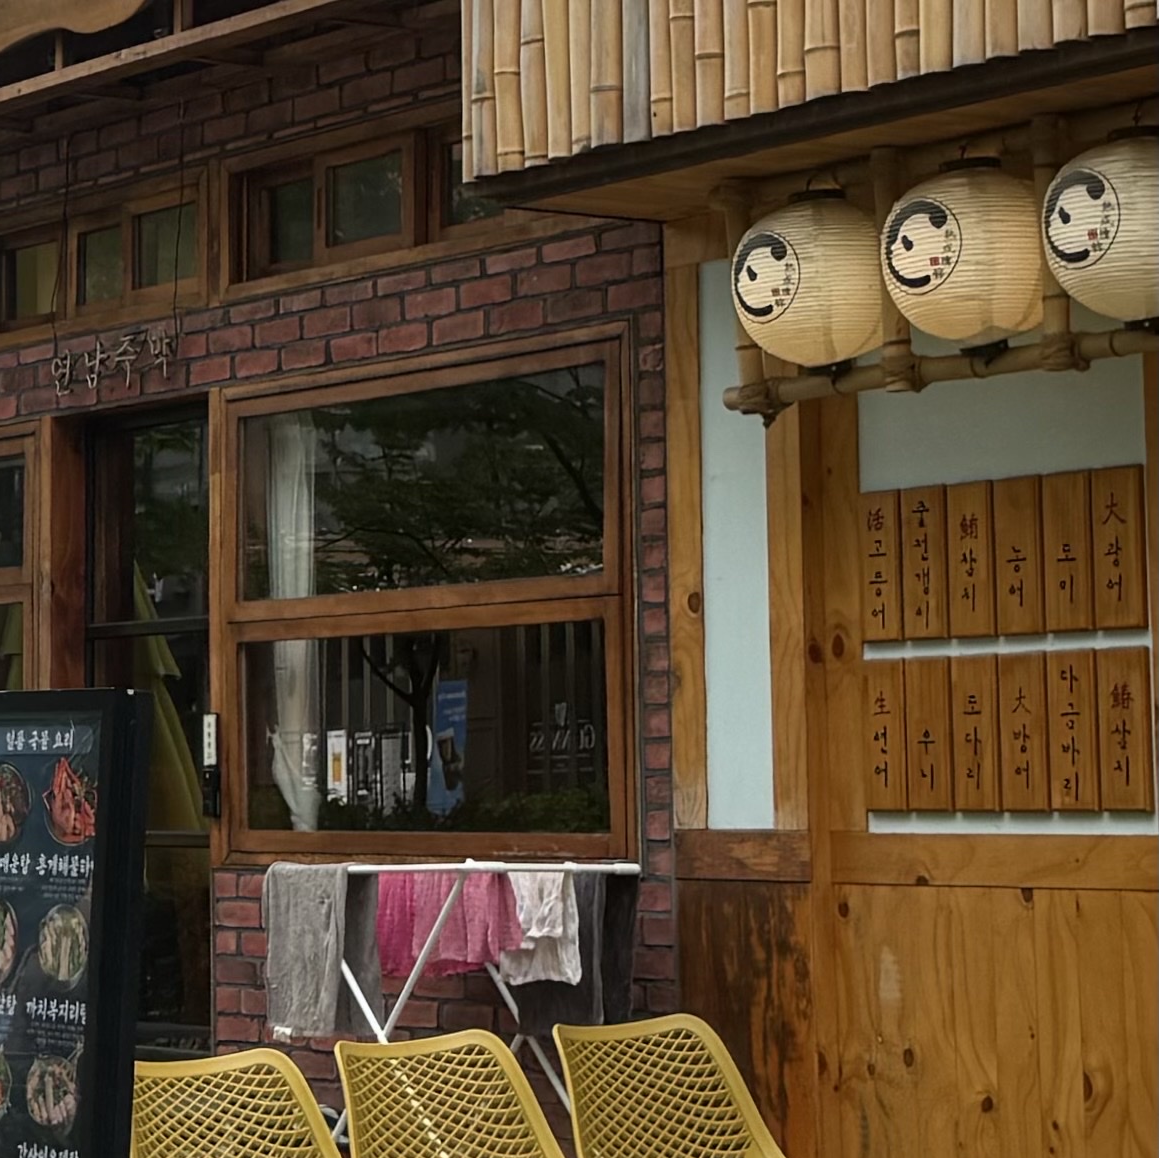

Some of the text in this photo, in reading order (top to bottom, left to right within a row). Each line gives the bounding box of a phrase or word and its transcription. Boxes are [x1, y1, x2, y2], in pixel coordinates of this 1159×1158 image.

[1006, 546, 1027, 607] 농어
[1057, 543, 1076, 604] 도미
[1102, 491, 1127, 602] 大광어
[873, 691, 891, 788] 生연어
[918, 729, 935, 791] 우니
[963, 695, 982, 790] 도다리
[1012, 686, 1032, 790] 大방어
[1060, 664, 1080, 801] 다금바리
